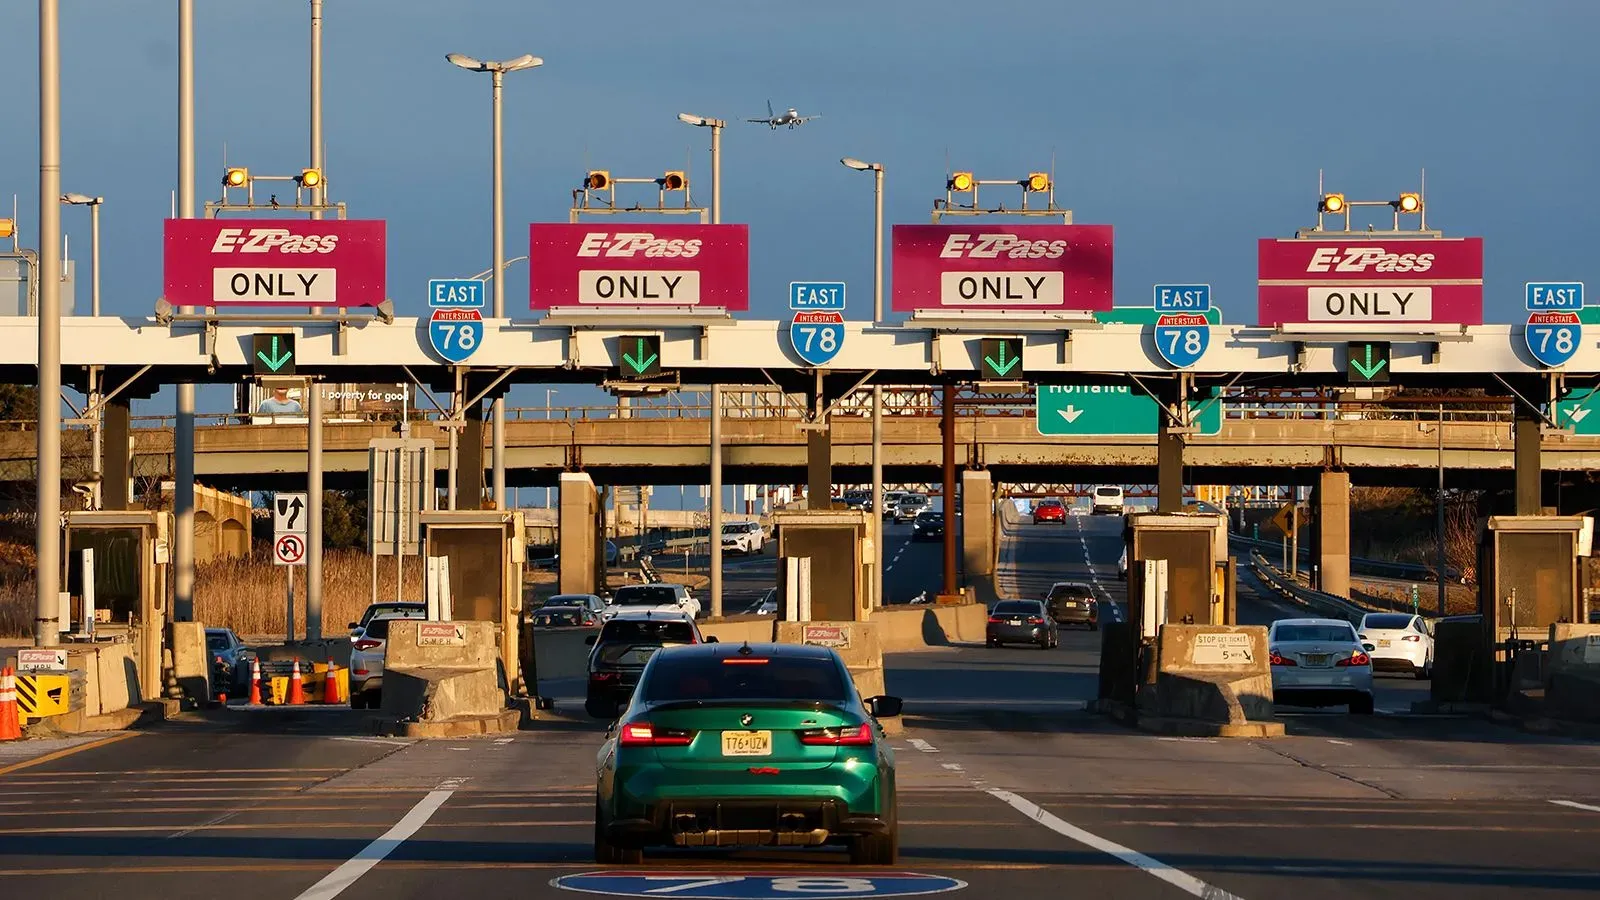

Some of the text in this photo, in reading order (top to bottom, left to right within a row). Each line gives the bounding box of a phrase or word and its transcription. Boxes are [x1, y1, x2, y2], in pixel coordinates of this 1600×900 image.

[231, 273, 319, 296] ONLY
[436, 284, 477, 302] EAST
[595, 275, 682, 298] ONLY
[958, 276, 1046, 300] ONLY
[797, 287, 838, 305] EAST
[1161, 289, 1203, 307] EAST
[1326, 292, 1414, 316] ONLY
[1533, 287, 1576, 305] EAST
[438, 325, 475, 350] 78
[800, 327, 836, 352] 78
[1164, 329, 1201, 355] 78
[1535, 328, 1573, 354] 78
[329, 391, 365, 401] poverty
[368, 389, 382, 399] for
[1198, 635, 1216, 643] STOP
[1229, 635, 1246, 643] TICKET
[1222, 650, 1229, 660] 5
[642, 876, 876, 893] 78
